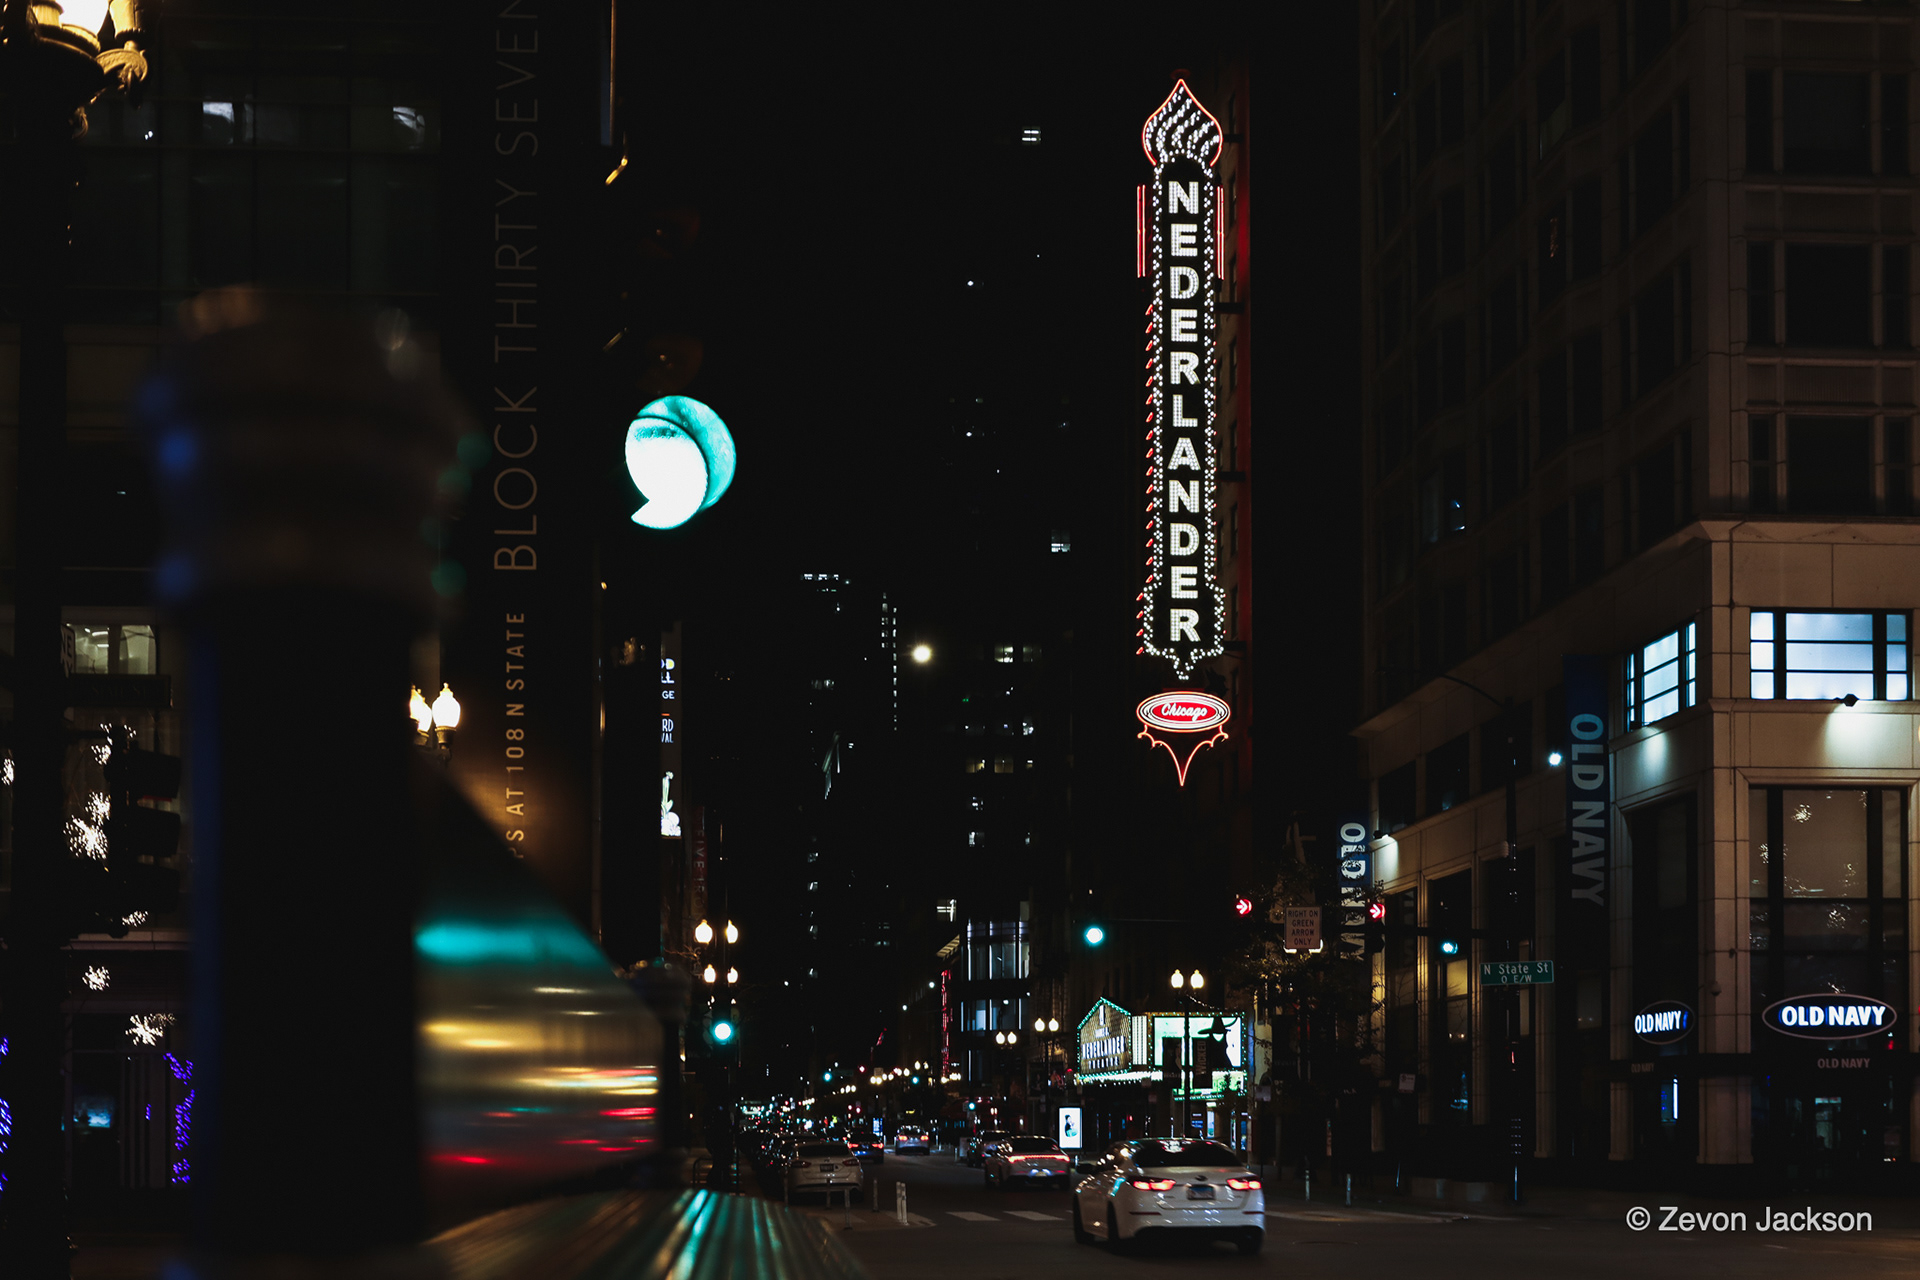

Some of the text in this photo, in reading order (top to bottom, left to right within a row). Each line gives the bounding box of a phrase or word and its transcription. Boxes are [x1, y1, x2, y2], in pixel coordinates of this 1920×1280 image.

[494, 178, 538, 363] THIRTY
[1167, 181, 1202, 642] NEDERLANDER
[494, 387, 538, 571] BLOCK
[506, 612, 525, 691] STATE
[506, 703, 525, 717] N
[1161, 702, 1209, 722] Chicago
[506, 728, 525, 773] 108
[506, 788, 525, 817] AT
[1570, 713, 1606, 906] OLD NAVY
[1339, 822, 1366, 880] OLD
[1288, 910, 1307, 918] RIGHT
[1292, 919, 1314, 927] GREEN
[1291, 928, 1315, 936] ARROW
[1293, 938, 1312, 946] ONLY
[1484, 962, 1549, 975] N State St
[1513, 974, 1532, 984] E/W
[1634, 1010, 1682, 1034] OLD NAVY
[1781, 1005, 1887, 1027] OLD NAVY
[1630, 1063, 1641, 1074] OLD
[1817, 1058, 1871, 1069] OLD NAVY
